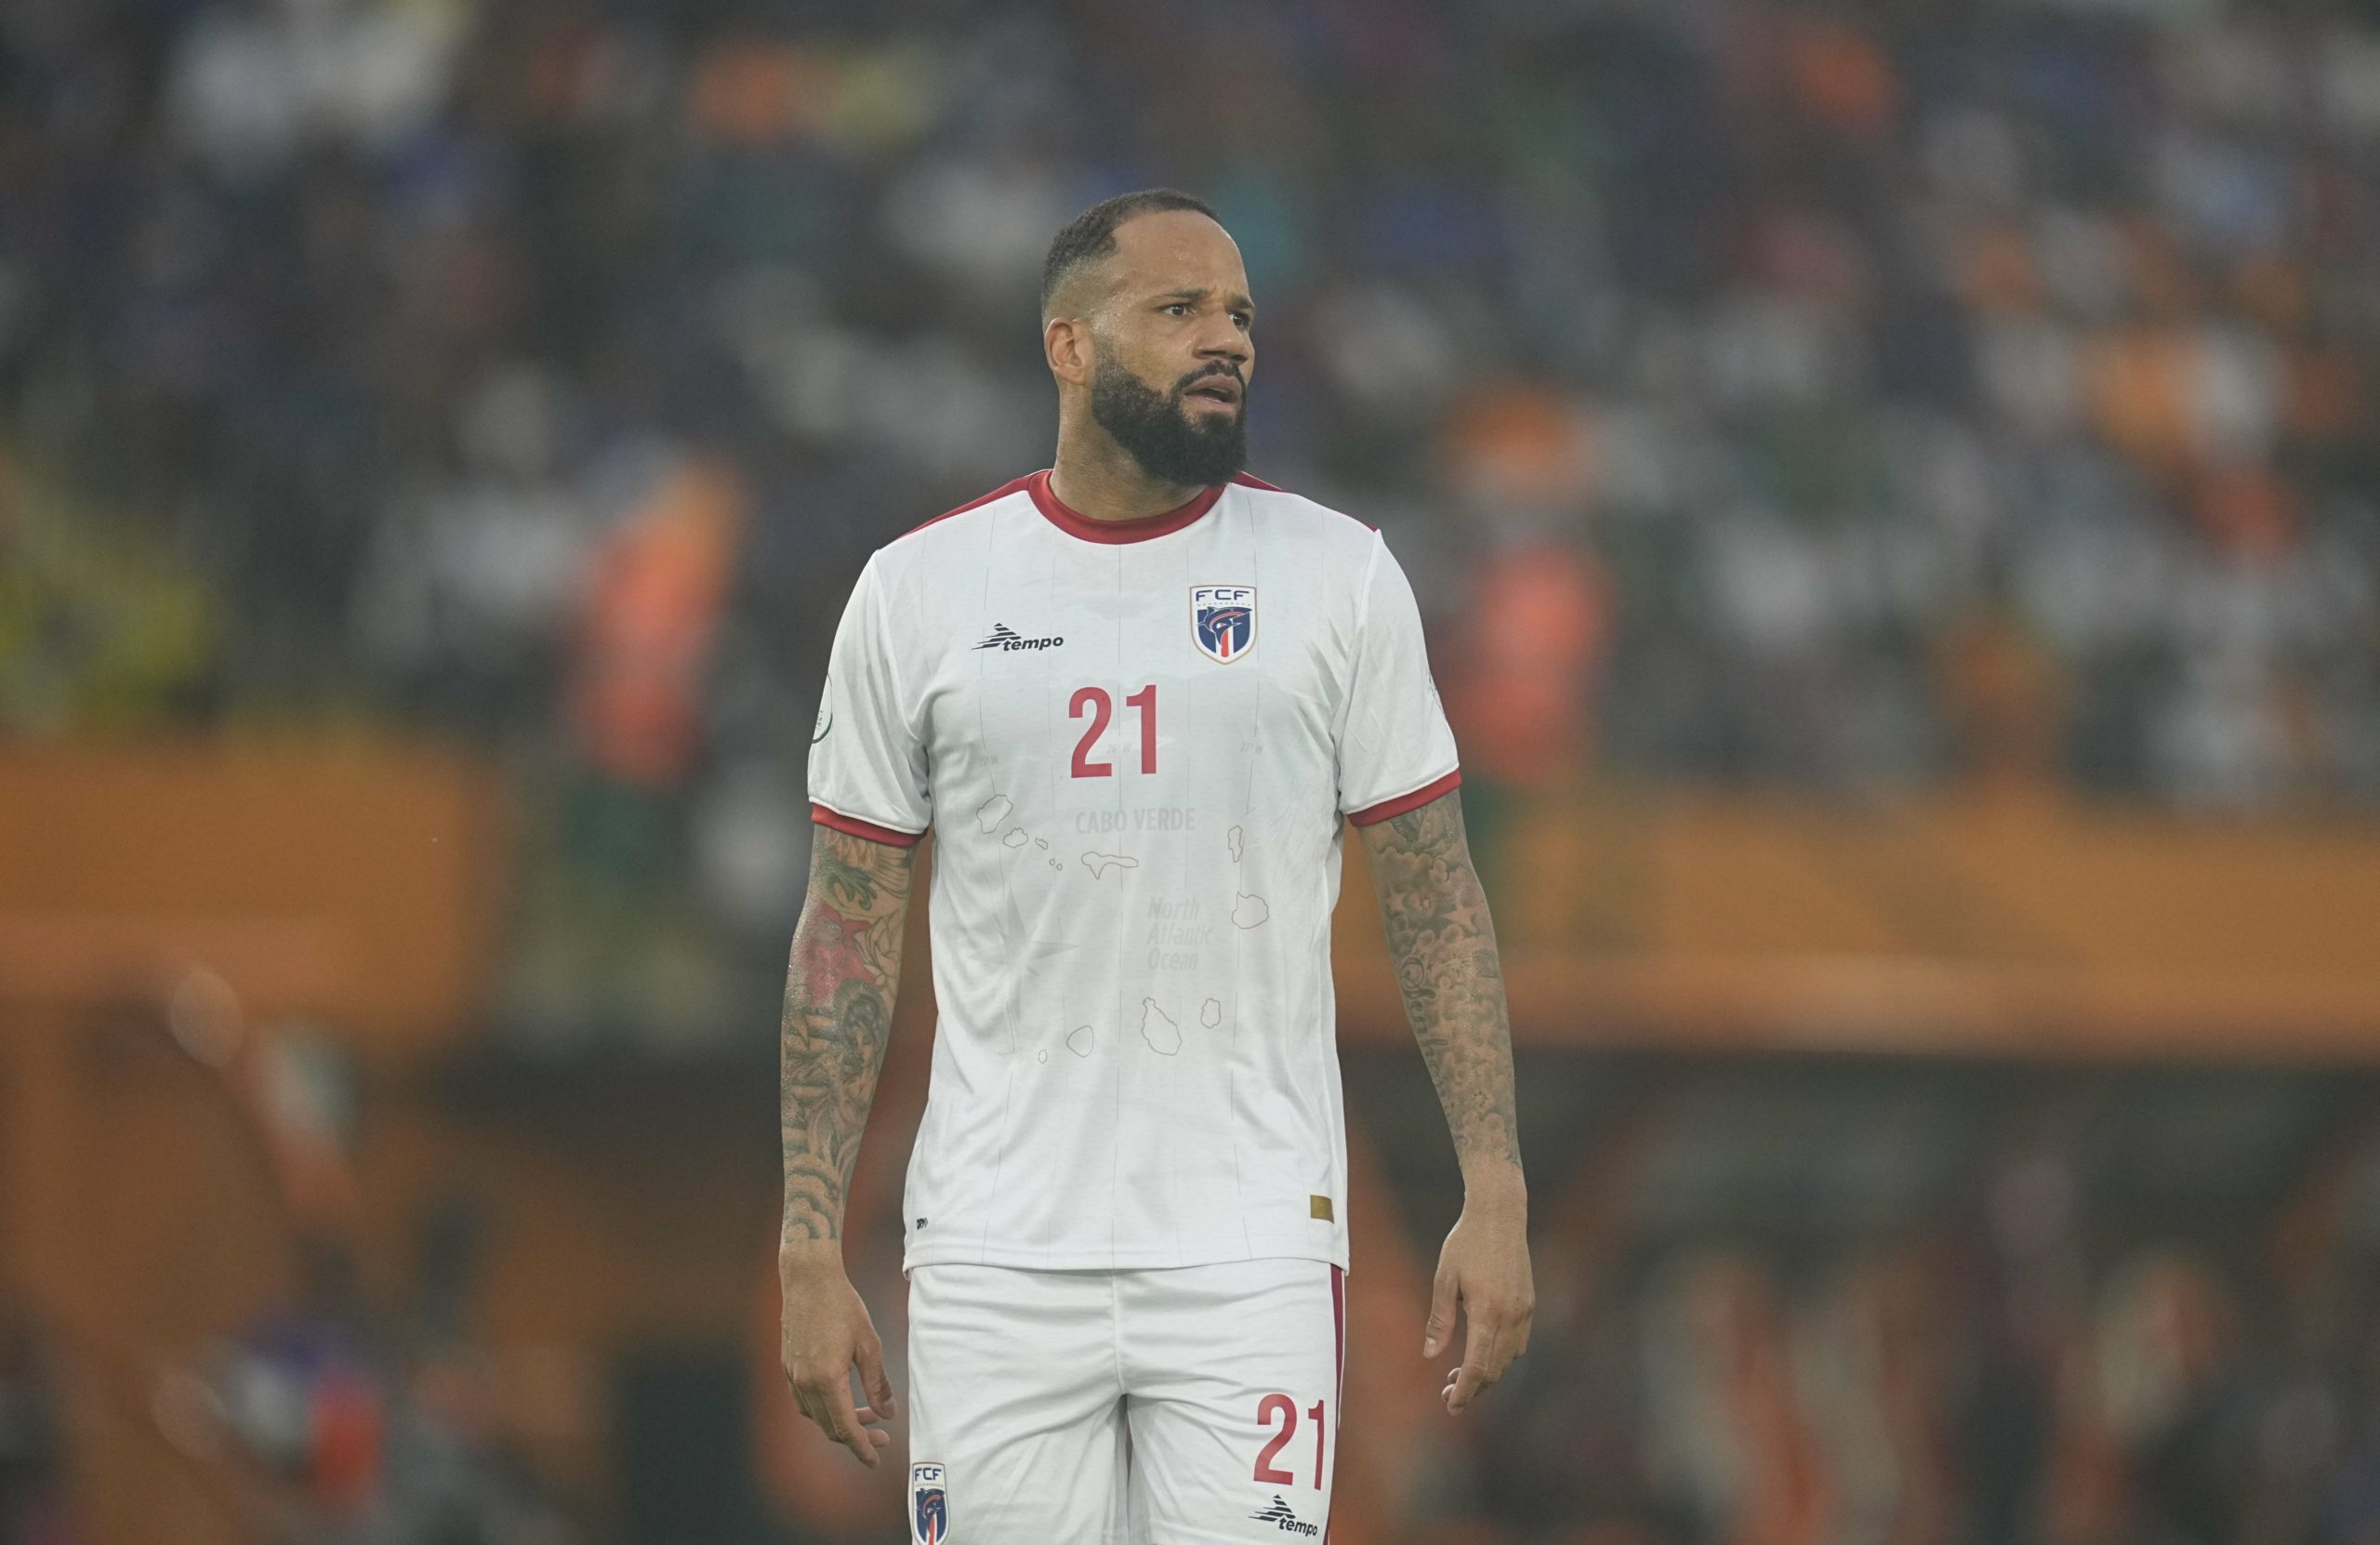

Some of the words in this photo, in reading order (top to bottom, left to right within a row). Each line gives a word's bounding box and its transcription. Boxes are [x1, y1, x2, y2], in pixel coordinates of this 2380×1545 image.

[1196, 589, 1250, 602] FCF
[1003, 637, 1064, 652] tempo
[1069, 684, 1157, 778] 21
[1076, 809, 1128, 835] CABO
[1133, 807, 1196, 831] VERDE
[1146, 896, 1200, 920] North
[1145, 921, 1213, 945] Atlantic
[1147, 946, 1199, 971] Ocean
[1253, 1393, 1325, 1491] 21
[915, 1468, 942, 1482] FCF
[1278, 1517, 1318, 1537] tempo
